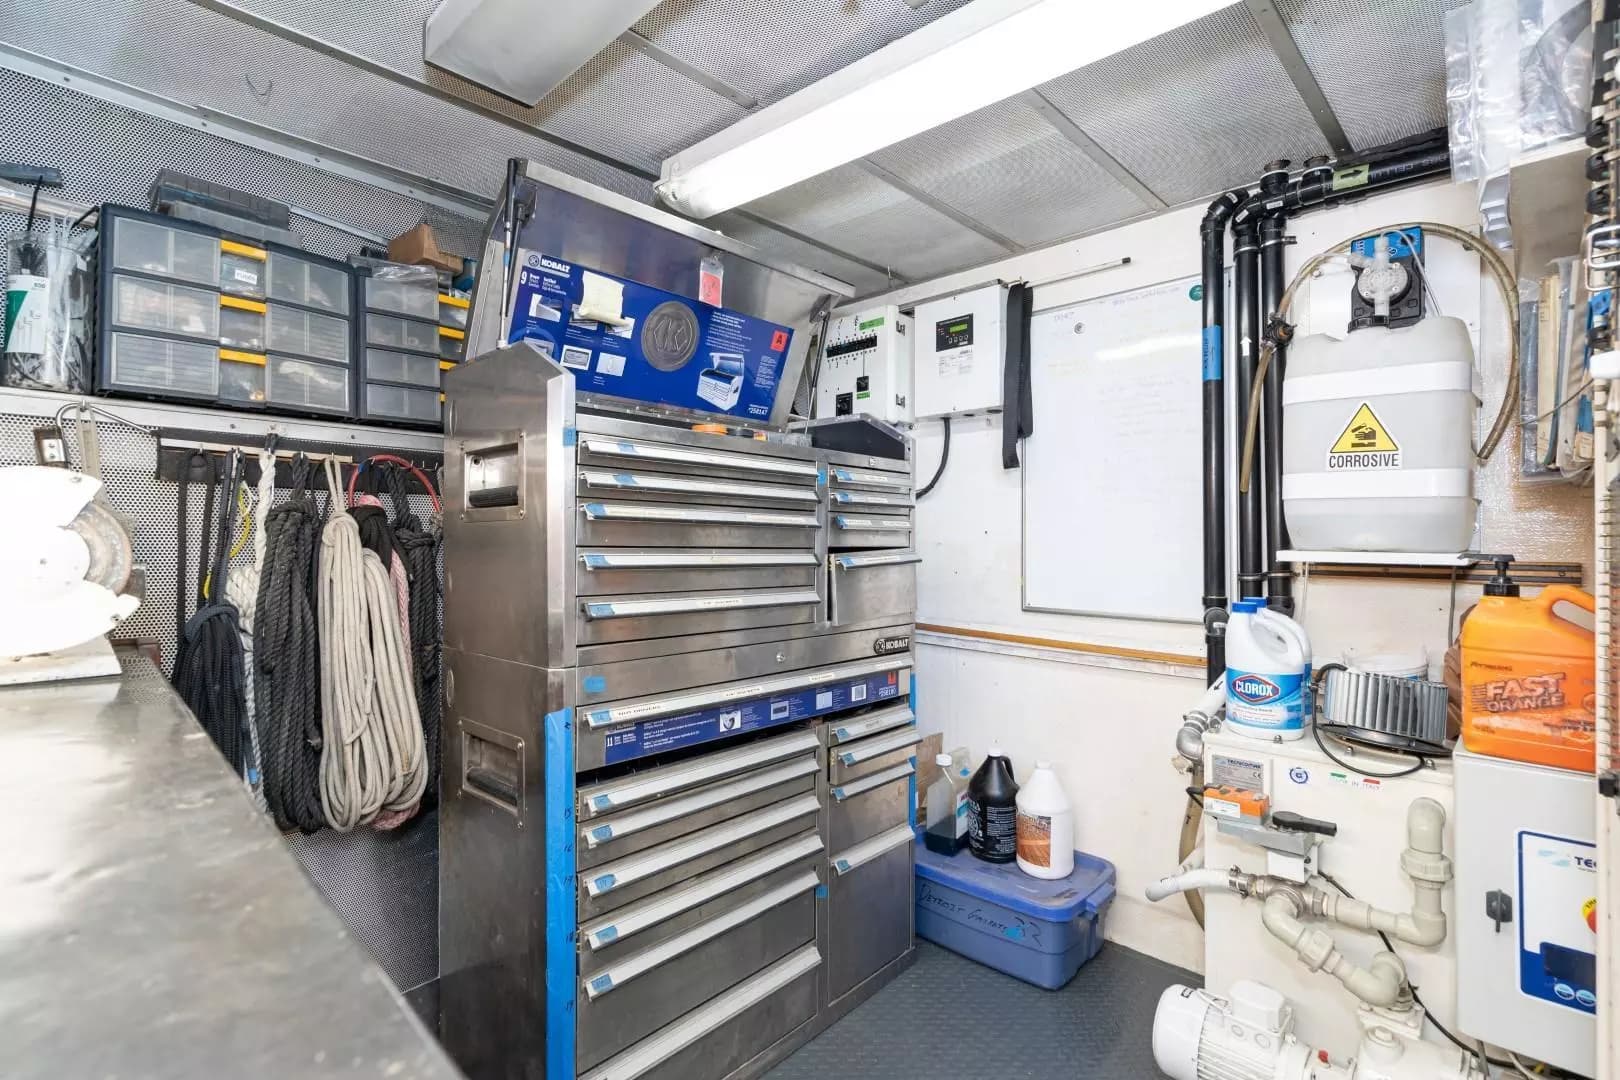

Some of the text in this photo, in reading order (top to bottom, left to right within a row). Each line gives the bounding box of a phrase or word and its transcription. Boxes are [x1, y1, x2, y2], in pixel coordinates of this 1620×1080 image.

[541, 258, 571, 273] KOBALT
[520, 271, 528, 285] 9
[1329, 453, 1399, 469] CORROSIVE
[885, 638, 909, 650] KOBALT
[1235, 680, 1273, 697] CLOROX
[1485, 671, 1566, 700] FAST
[1485, 691, 1565, 713] ORANGE
